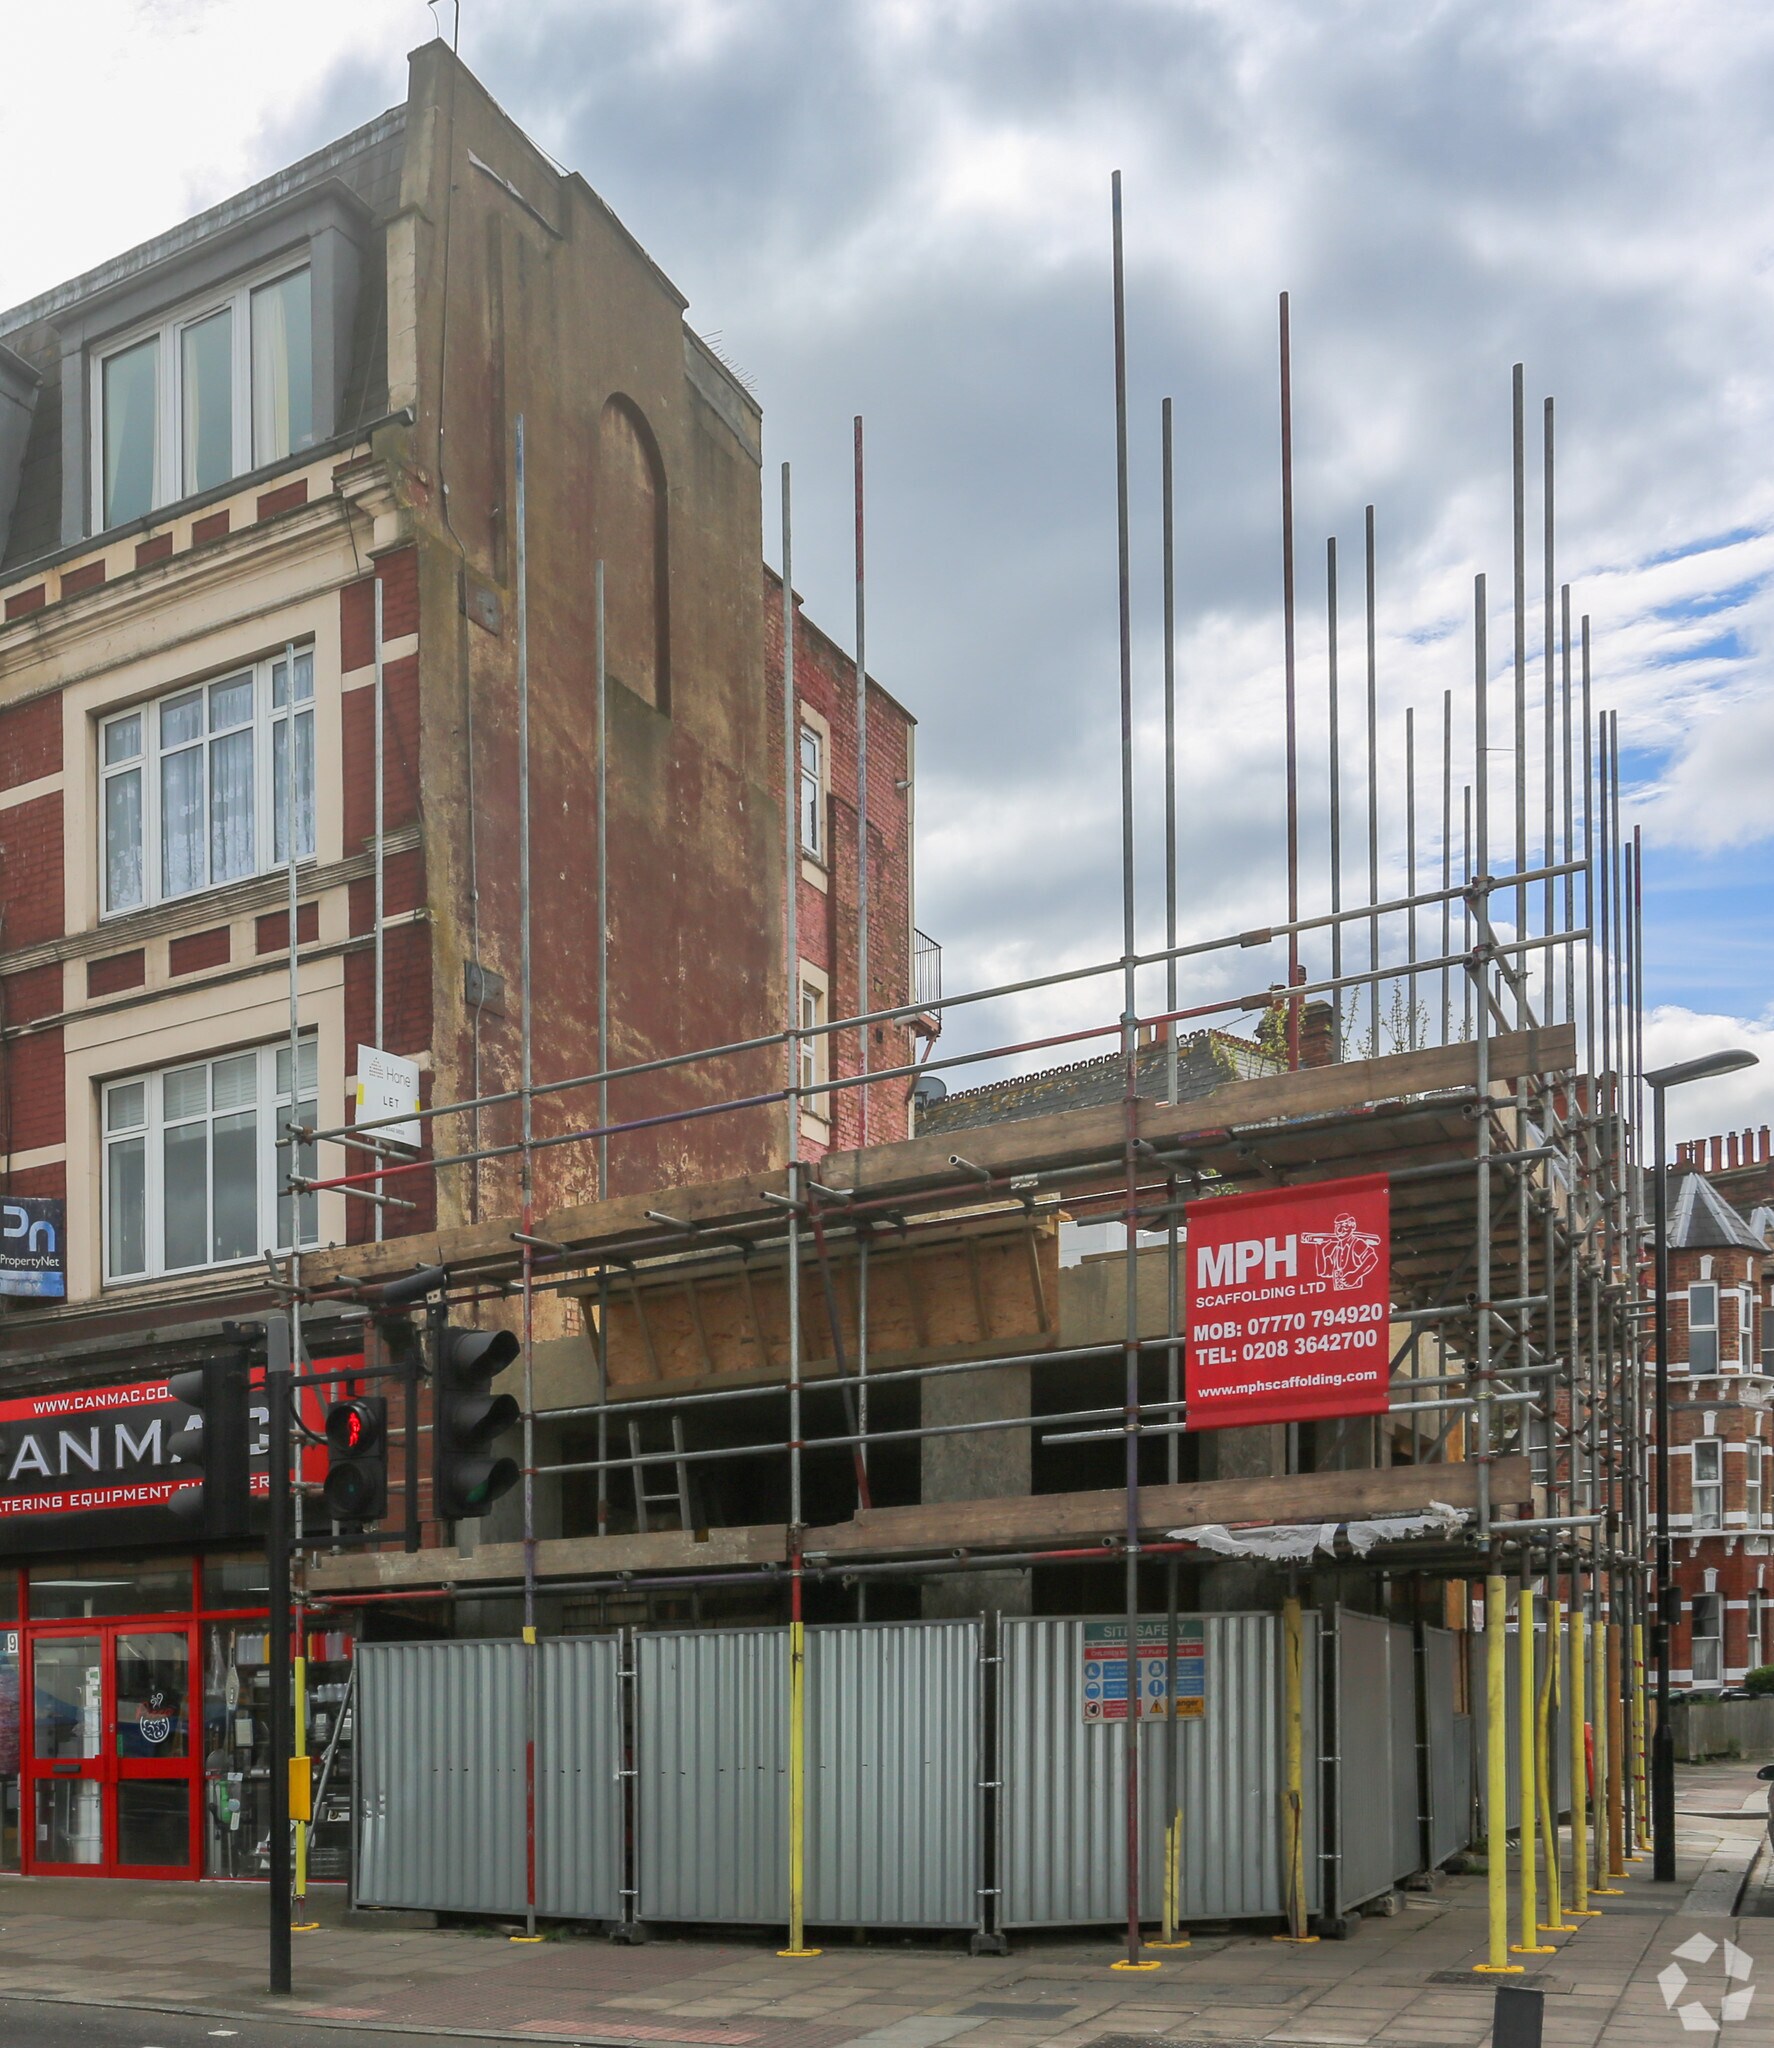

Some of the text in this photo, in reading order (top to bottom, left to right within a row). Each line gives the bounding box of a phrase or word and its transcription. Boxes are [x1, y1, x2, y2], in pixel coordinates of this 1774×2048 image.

[383, 1096, 399, 1108] LET
[0, 1254, 60, 1268] PropertyNet
[1197, 1234, 1297, 1289] MPH
[1196, 1281, 1327, 1308] SCAFFOLDING LTD
[1193, 1303, 1383, 1342] MOB: 07770 794920
[1196, 1329, 1377, 1366] TEL: 0208 3642700
[1198, 1370, 1377, 1398] www.mphscaffolding.com
[70, 1485, 172, 1507] EQUIPMENT
[1136, 1623, 1185, 1637] SAFEY
